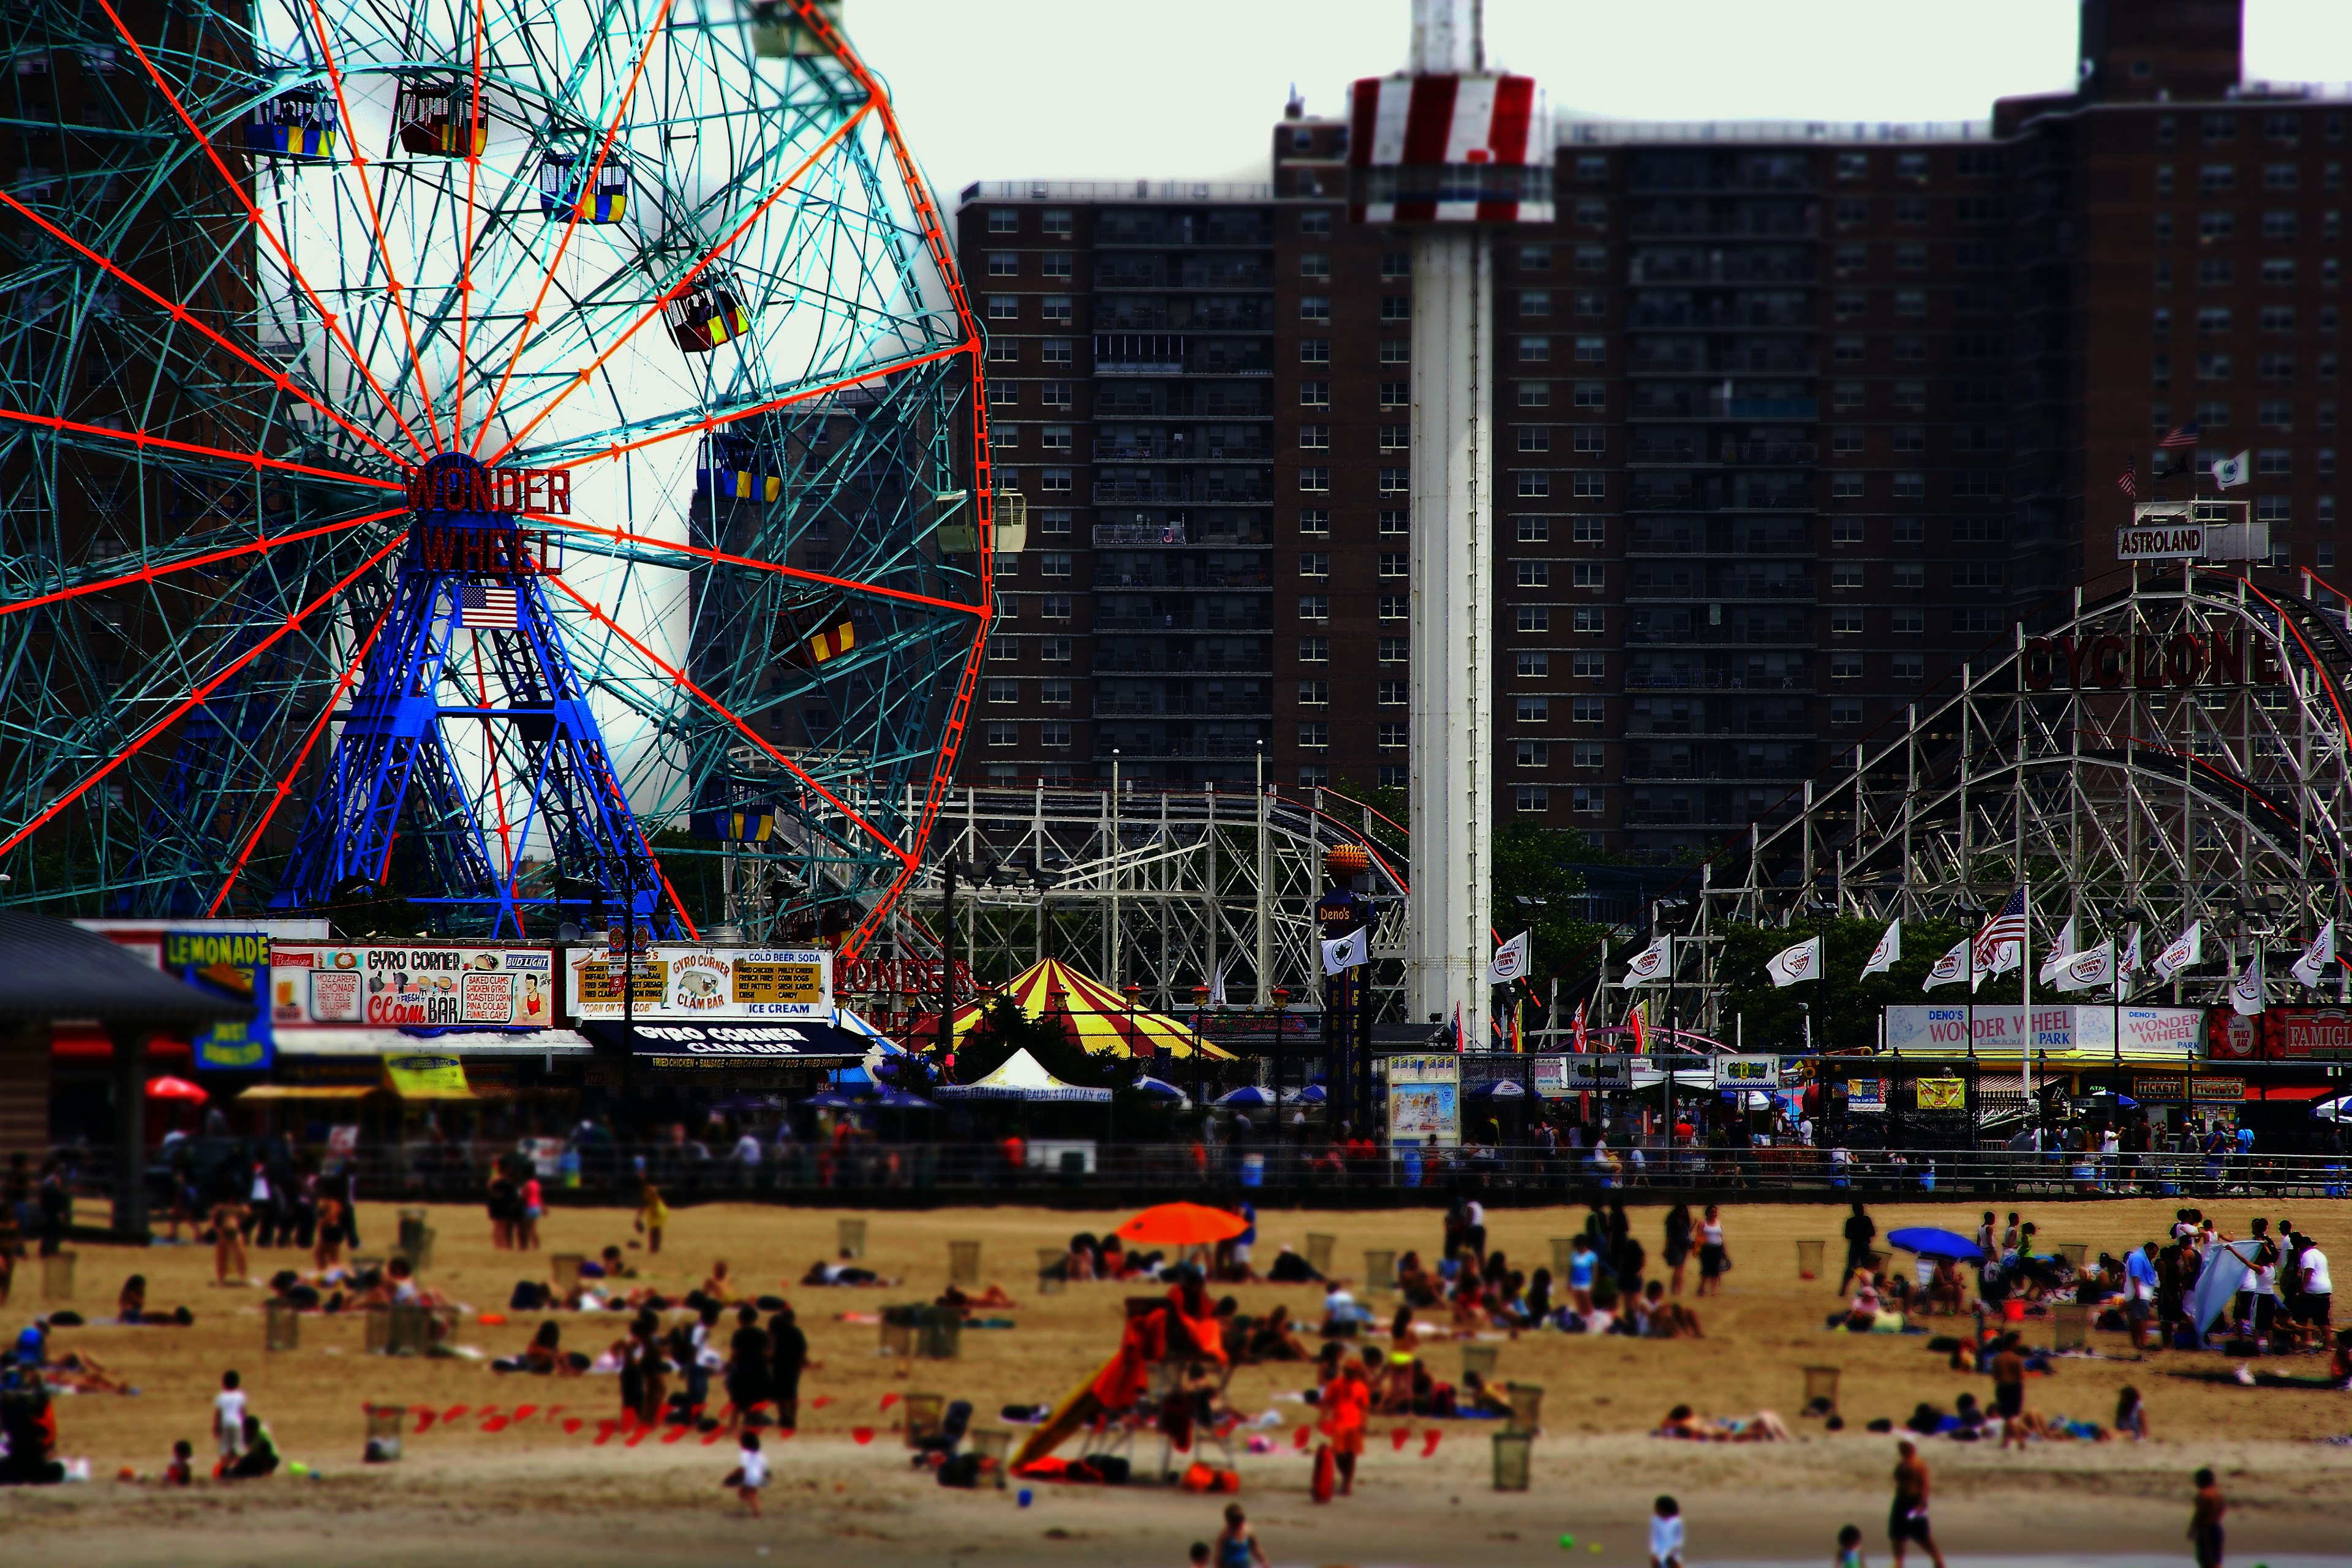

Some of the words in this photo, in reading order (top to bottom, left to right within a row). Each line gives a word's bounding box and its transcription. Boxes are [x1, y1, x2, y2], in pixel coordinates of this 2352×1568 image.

[403, 466, 570, 514] WONDER
[2121, 529, 2201, 554] ASTROLAND
[421, 527, 562, 575] WHEEL
[2024, 633, 2284, 690] CYCLONE
[1321, 907, 1349, 920] Deno's
[168, 935, 268, 965] LEMONADE
[274, 954, 310, 967] Budweiser
[368, 951, 407, 970] GYRO
[410, 951, 460, 970] CORNER
[507, 957, 522, 967] BUD
[525, 958, 548, 967] LIGHT
[798, 954, 821, 962] SODA
[673, 955, 696, 974] GYRO
[698, 955, 730, 978] CORNER
[317, 984, 355, 992] LEMONADE
[401, 993, 420, 1002] FRESH
[677, 993, 704, 1009] CLAM
[707, 994, 724, 1009] BAR
[368, 995, 426, 1023] Clam
[428, 997, 458, 1023] BAR
[749, 1005, 764, 1013] ICE
[768, 1005, 810, 1013] CREAM
[1929, 1011, 1964, 1020] DENO'S
[1930, 1017, 2005, 1042] WONDER
[2129, 1014, 2199, 1033] WONDER
[633, 1026, 706, 1041] GYRO
[707, 1028, 809, 1041] CORNER
[2040, 1033, 2070, 1044] PARK
[2140, 1027, 2193, 1043] WHEEL
[2233, 1030, 2251, 1039] SNACK
[2290, 1027, 2352, 1046] FAMIGL
[687, 1043, 753, 1053] CLAM
[750, 1044, 799, 1053] BAR
[2236, 1039, 2248, 1047] BAR
[652, 1058, 669, 1067] FRIED
[669, 1058, 694, 1067] CHICKEN
[699, 1059, 725, 1068] SAUSAGE
[804, 1059, 820, 1068] FRIED
[971, 1088, 1005, 1099] ITALIAN
[1008, 1090, 1023, 1099] ICES
[2140, 1082, 2180, 1093] TICKETS
[2193, 1084, 2239, 1095] TICKETS
[1027, 1090, 1058, 1099] RALPH'S
[1061, 1090, 1094, 1100] ITALIAN
[1097, 1092, 1110, 1101] ICES
